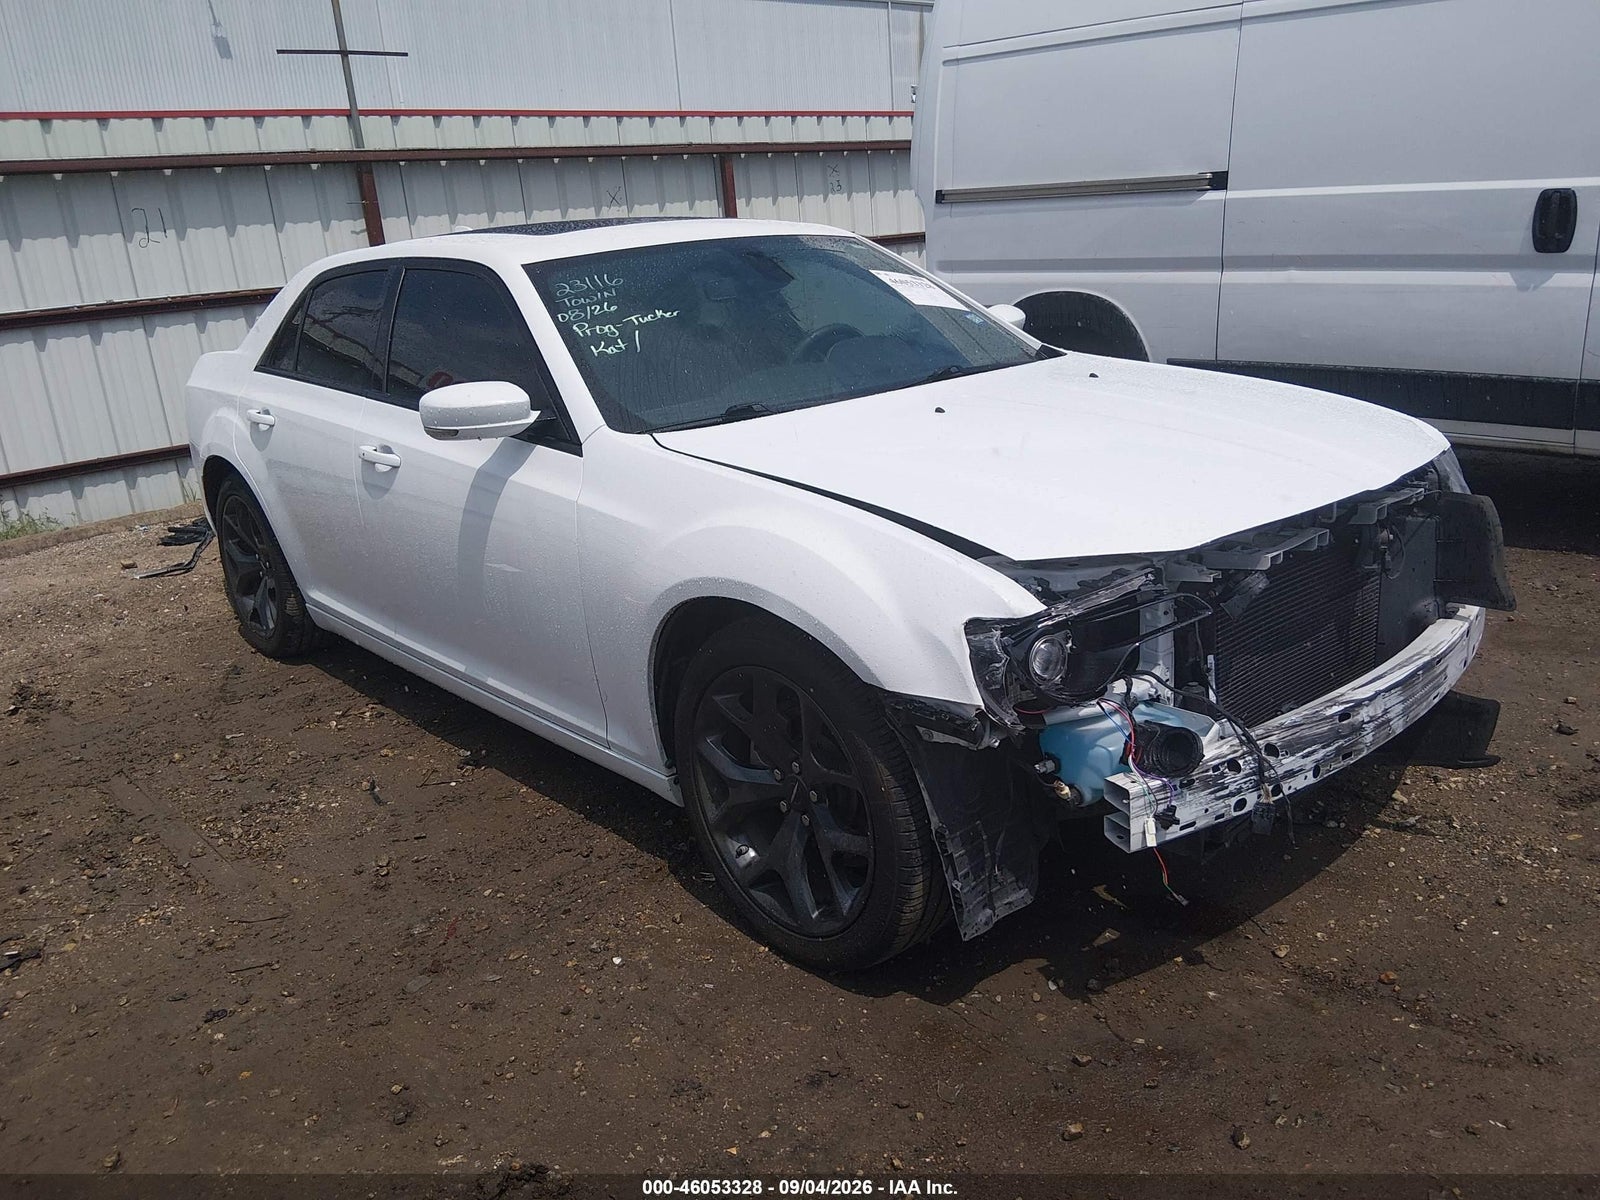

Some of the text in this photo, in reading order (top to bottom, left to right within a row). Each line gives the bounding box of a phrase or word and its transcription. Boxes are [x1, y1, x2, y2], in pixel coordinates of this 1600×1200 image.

[131, 207, 168, 248] 21
[555, 274, 623, 297] 23116
[557, 302, 618, 323] 08/26
[590, 338, 628, 357] Kat
